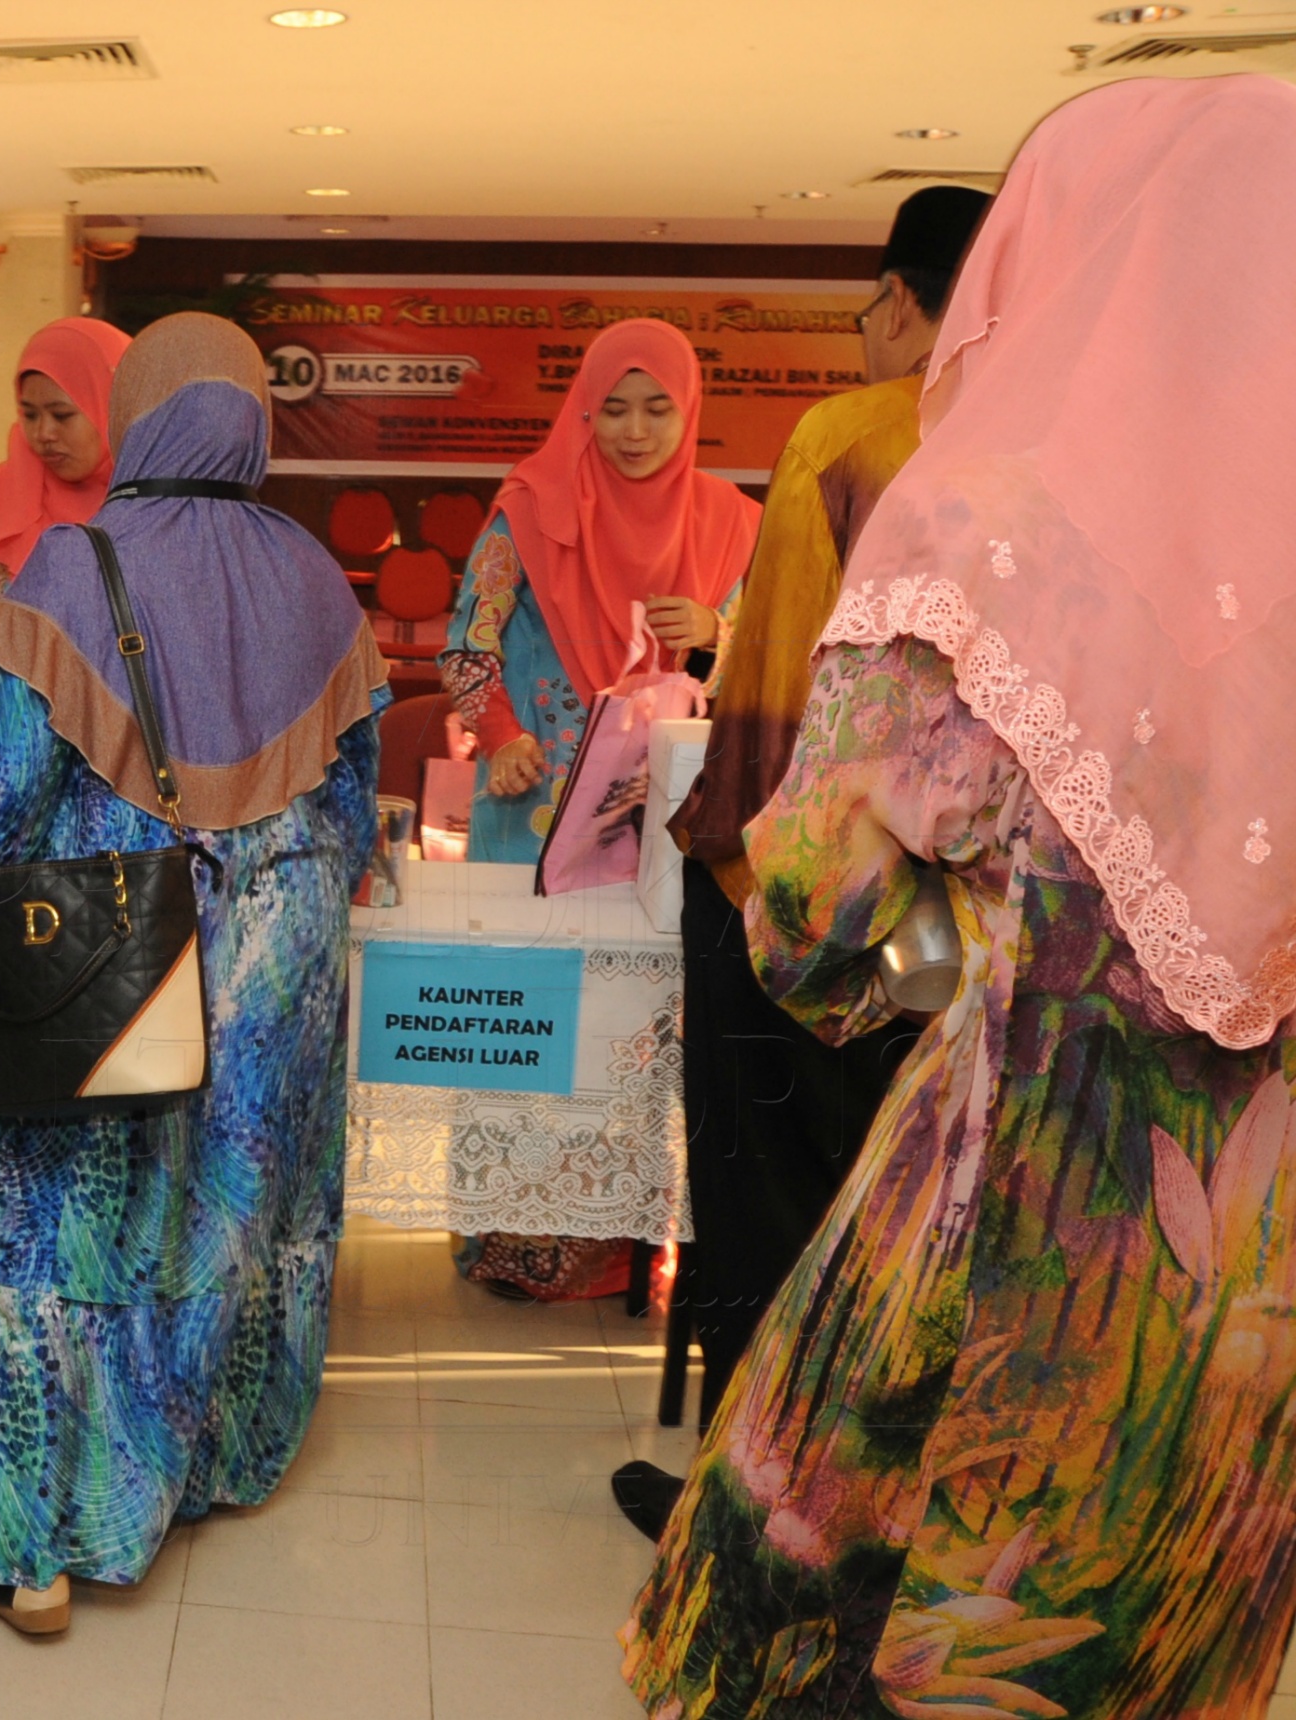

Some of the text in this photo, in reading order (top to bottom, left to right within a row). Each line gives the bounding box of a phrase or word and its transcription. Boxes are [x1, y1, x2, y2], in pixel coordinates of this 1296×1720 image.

[389, 296, 553, 328] KELUARGA
[267, 355, 315, 388] 10
[334, 364, 461, 384] MAC 2016
[711, 368, 782, 384] RAZALI
[786, 369, 820, 384] BIN
[22, 899, 60, 946] D
[418, 986, 524, 1007] KAUNTER
[385, 1013, 554, 1037] PENDAFTARAN
[394, 1044, 540, 1067] AGENSI LUAR
